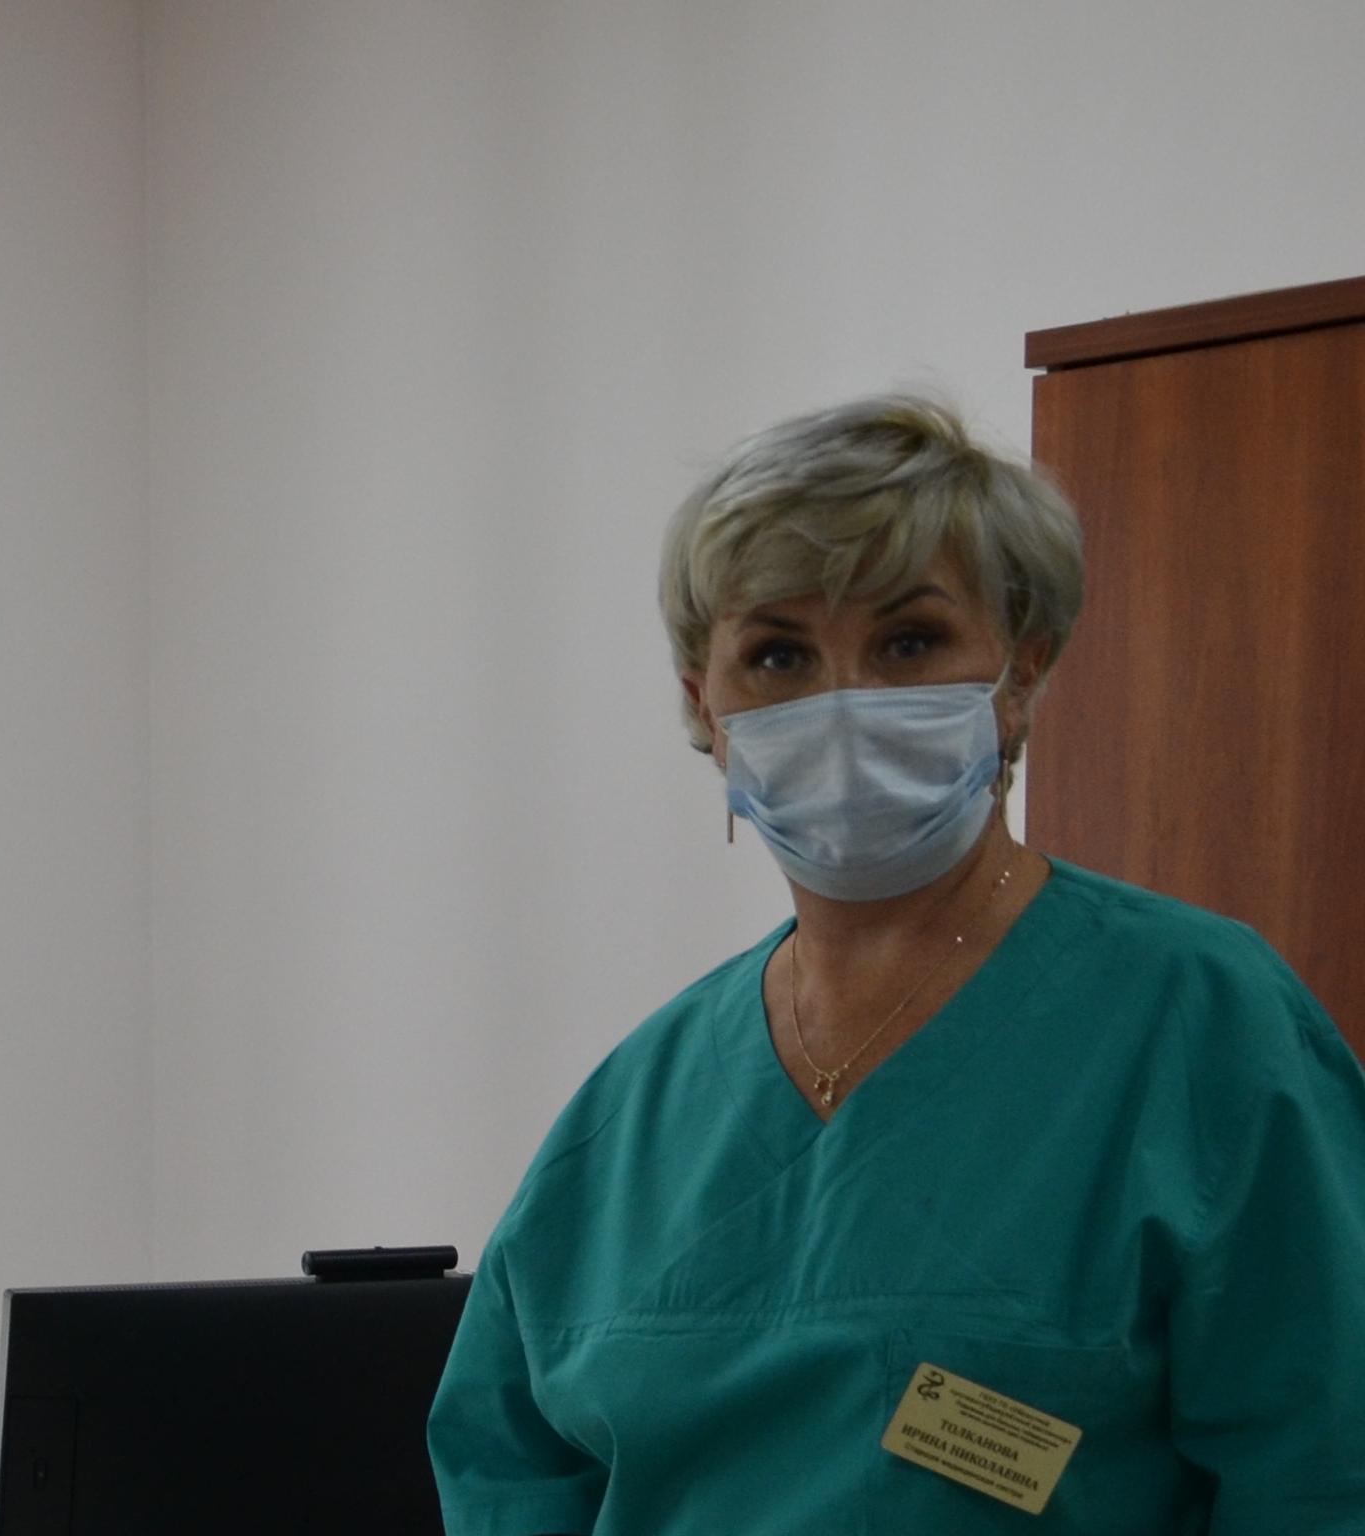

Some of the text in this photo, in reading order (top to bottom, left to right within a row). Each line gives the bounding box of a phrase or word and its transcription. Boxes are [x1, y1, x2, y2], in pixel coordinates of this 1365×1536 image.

[901, 1424, 948, 1453] ИРИНА
[951, 1446, 1039, 1491] НИКОЛАЕВНА
[940, 1418, 1019, 1461] ТОЛКАНОВА
